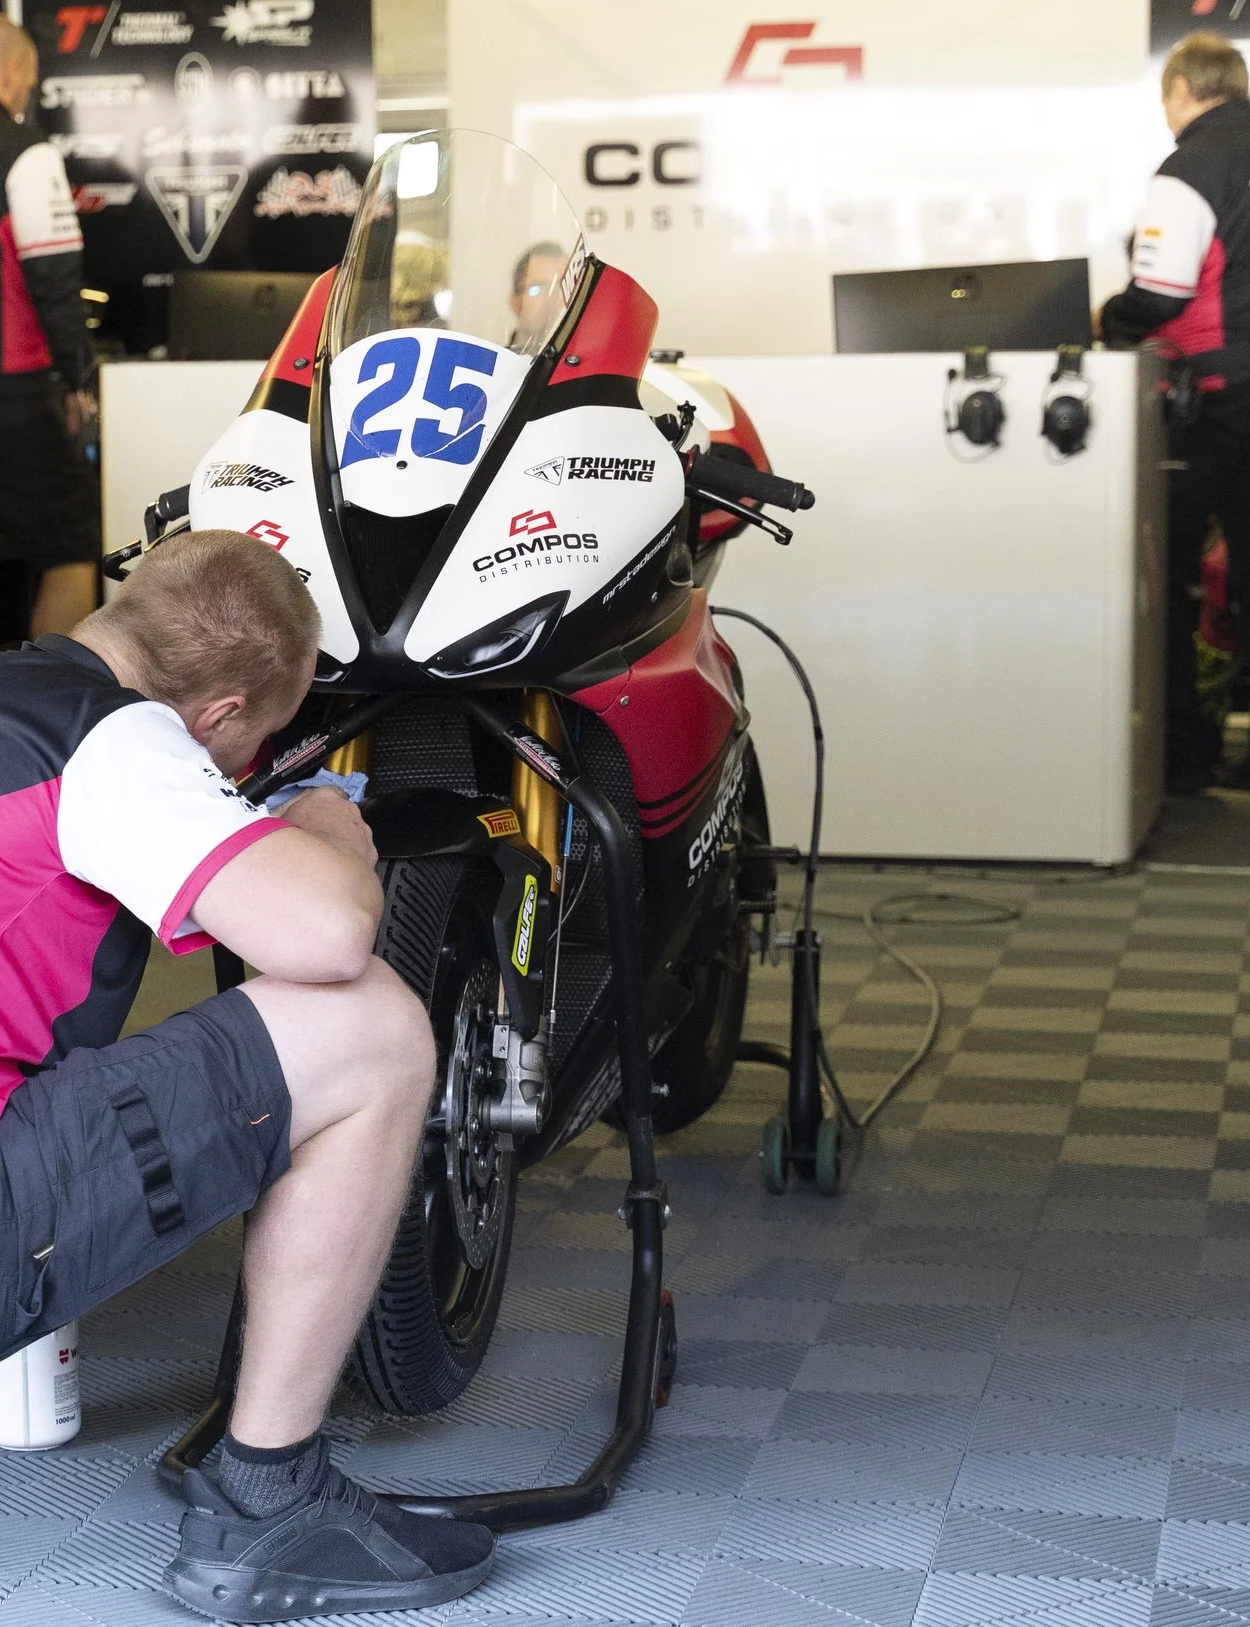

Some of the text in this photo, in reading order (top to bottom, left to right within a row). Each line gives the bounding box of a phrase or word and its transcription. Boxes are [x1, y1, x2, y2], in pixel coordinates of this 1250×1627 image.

[561, 238, 585, 303] WRS
[339, 337, 498, 465] 25
[220, 464, 295, 486] TRIUMPH
[567, 457, 655, 471] TRIUMPH
[567, 469, 653, 482] RACING
[210, 476, 274, 492] RACING
[472, 533, 598, 572] COMPOS
[479, 555, 599, 583] DISTRIBUTION
[483, 811, 517, 834] PIRELLI
